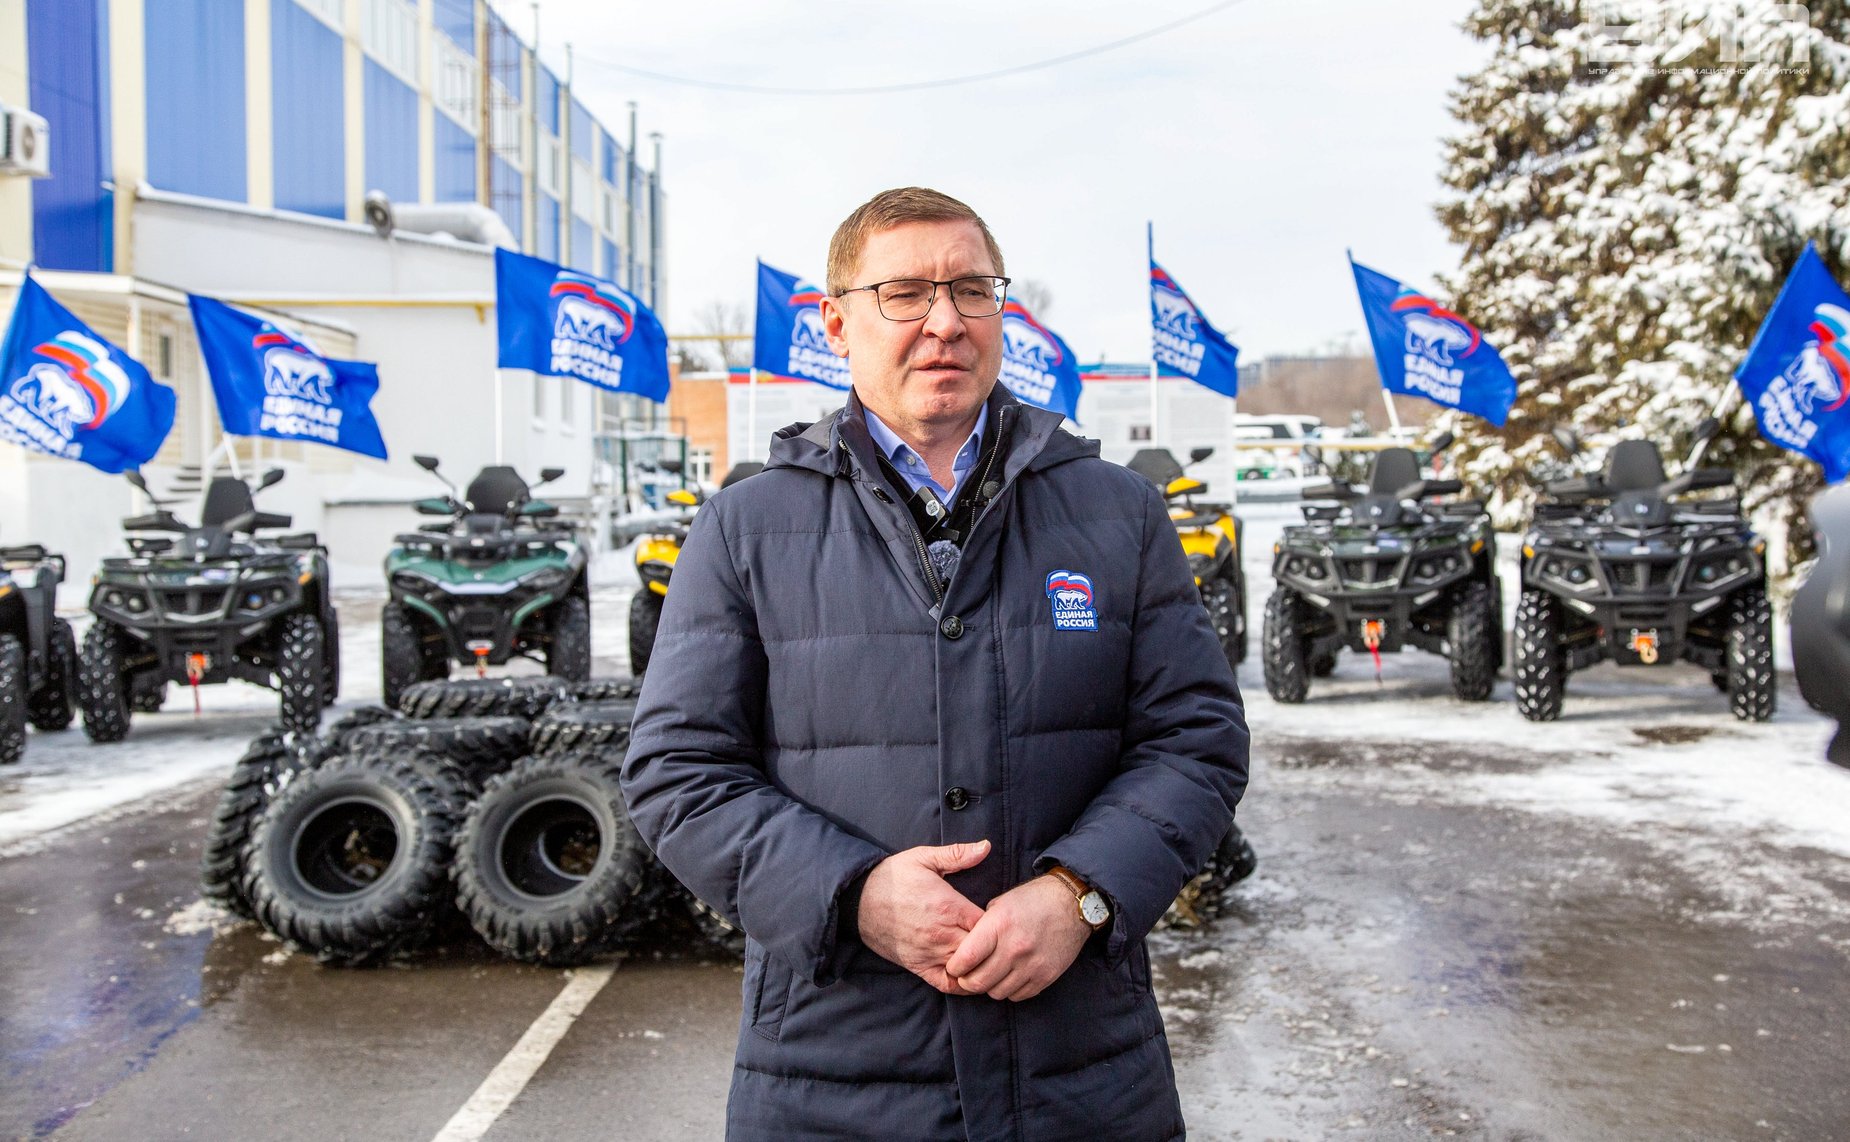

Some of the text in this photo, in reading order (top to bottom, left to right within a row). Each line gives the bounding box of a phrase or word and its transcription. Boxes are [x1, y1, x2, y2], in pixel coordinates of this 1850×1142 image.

[551, 338, 623, 372] ЕДИНАЯ
[788, 345, 849, 371] ЕДИНА
[1153, 328, 1205, 361] ИНАЯ
[550, 355, 621, 388] РОССИЯ
[787, 360, 852, 387] РОССИ
[1153, 345, 1201, 377] ССИЯ
[1404, 353, 1464, 387] ЕДИНАЯ
[1000, 373, 1052, 405] ССИЯ
[1404, 371, 1461, 405] РОССИЯ
[260, 412, 339, 443] РОССИЯ
[263, 396, 343, 427] ЕДИНАЯ
[1055, 610, 1093, 619] ЕДИНАЯ
[1057, 619, 1095, 627] РОССИЯ
